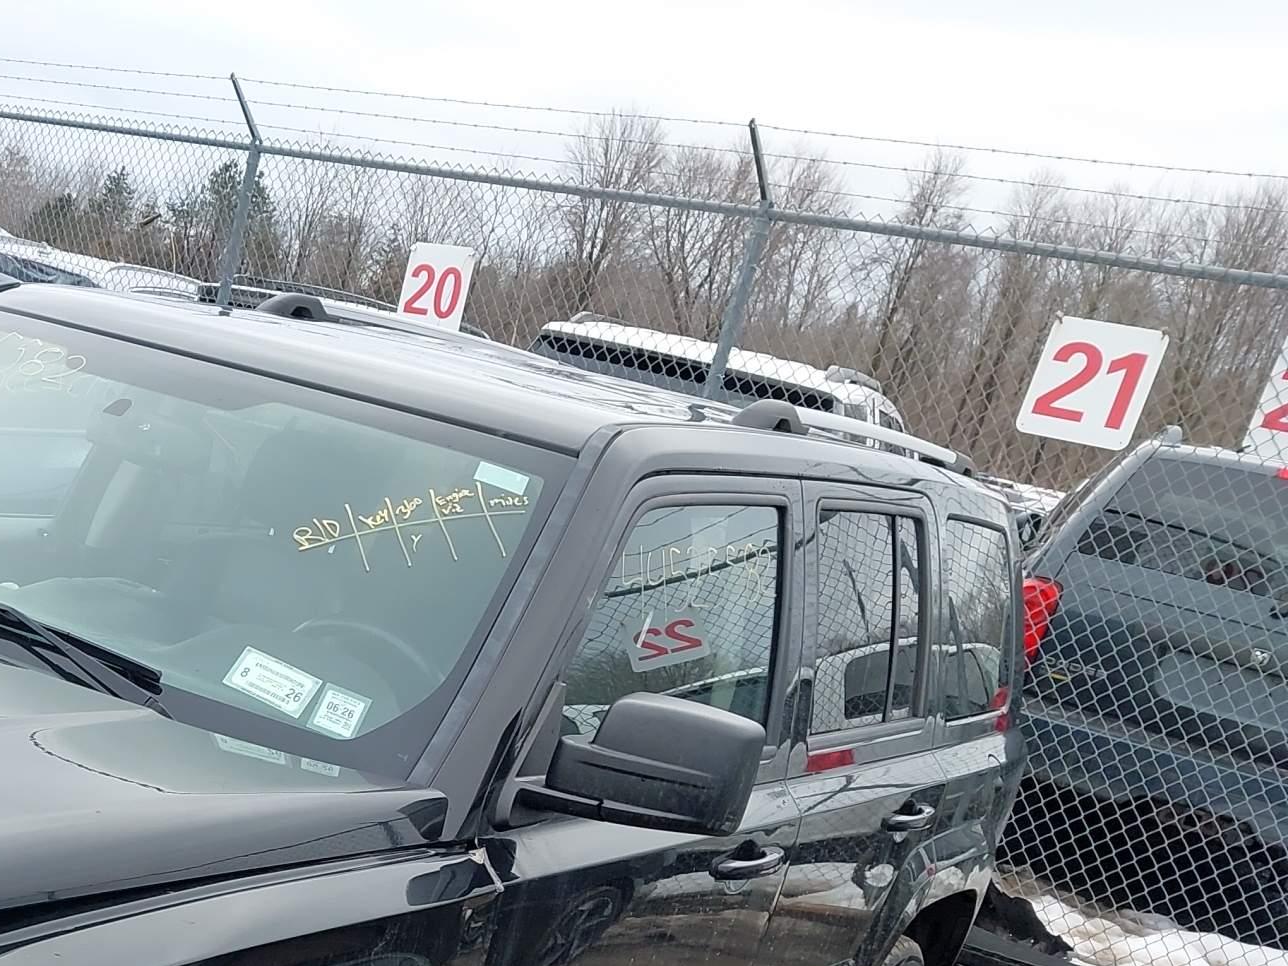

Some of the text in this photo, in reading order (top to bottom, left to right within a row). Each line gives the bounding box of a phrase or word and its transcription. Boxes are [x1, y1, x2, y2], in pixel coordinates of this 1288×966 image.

[403, 264, 462, 319] 20
[1031, 341, 1149, 430] 21
[240, 667, 251, 678] 8
[284, 687, 304, 703] 26
